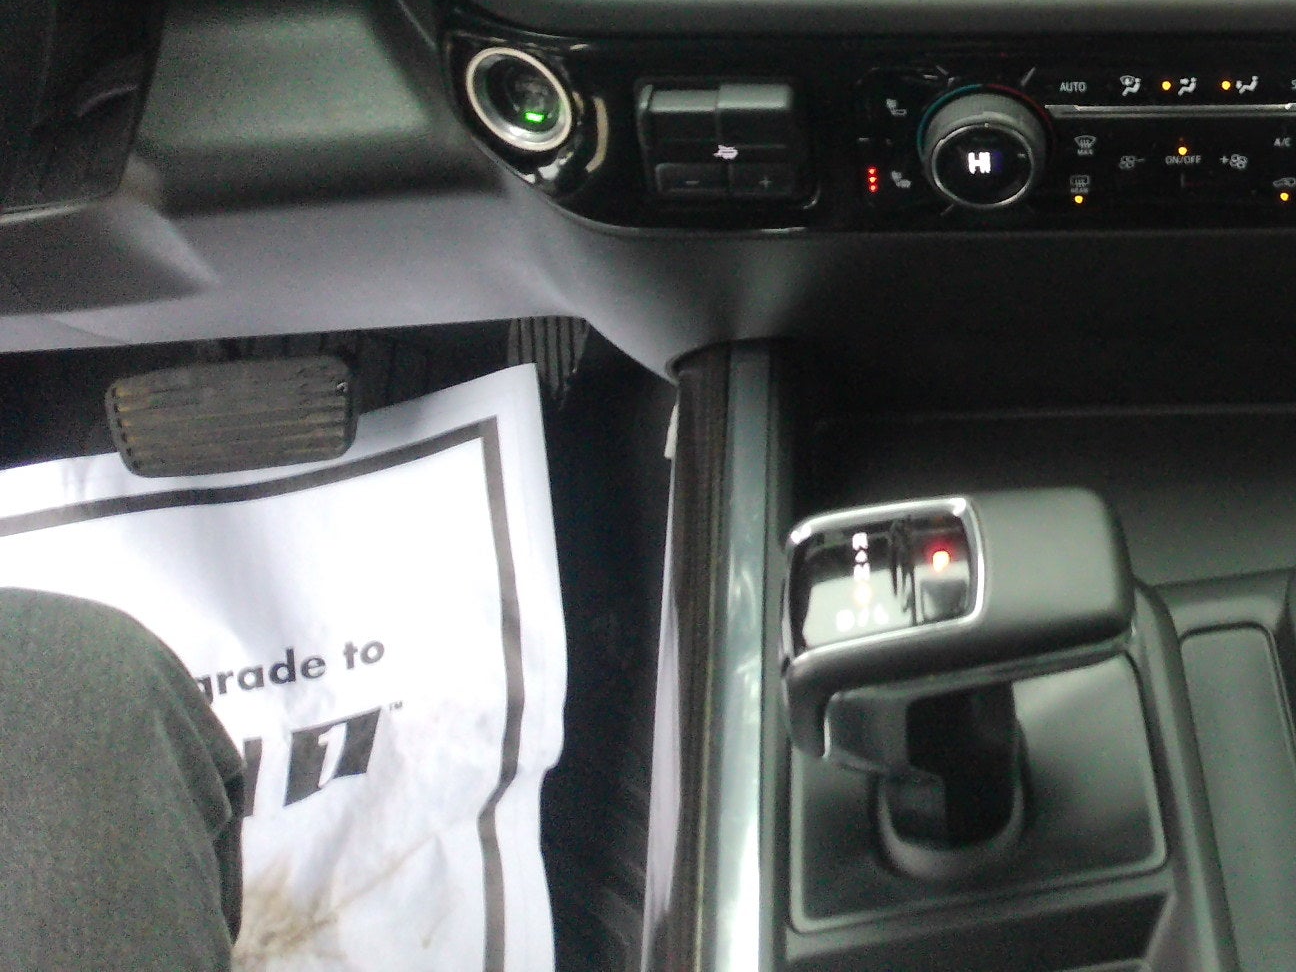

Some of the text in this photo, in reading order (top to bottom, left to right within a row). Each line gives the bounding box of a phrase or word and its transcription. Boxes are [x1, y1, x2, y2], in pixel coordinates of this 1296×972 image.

[1060, 81, 1087, 93] AUTO
[1273, 137, 1293, 148] A/C
[967, 151, 993, 175] HI
[1165, 154, 1201, 166] ON/OFF
[343, 641, 385, 670] to
